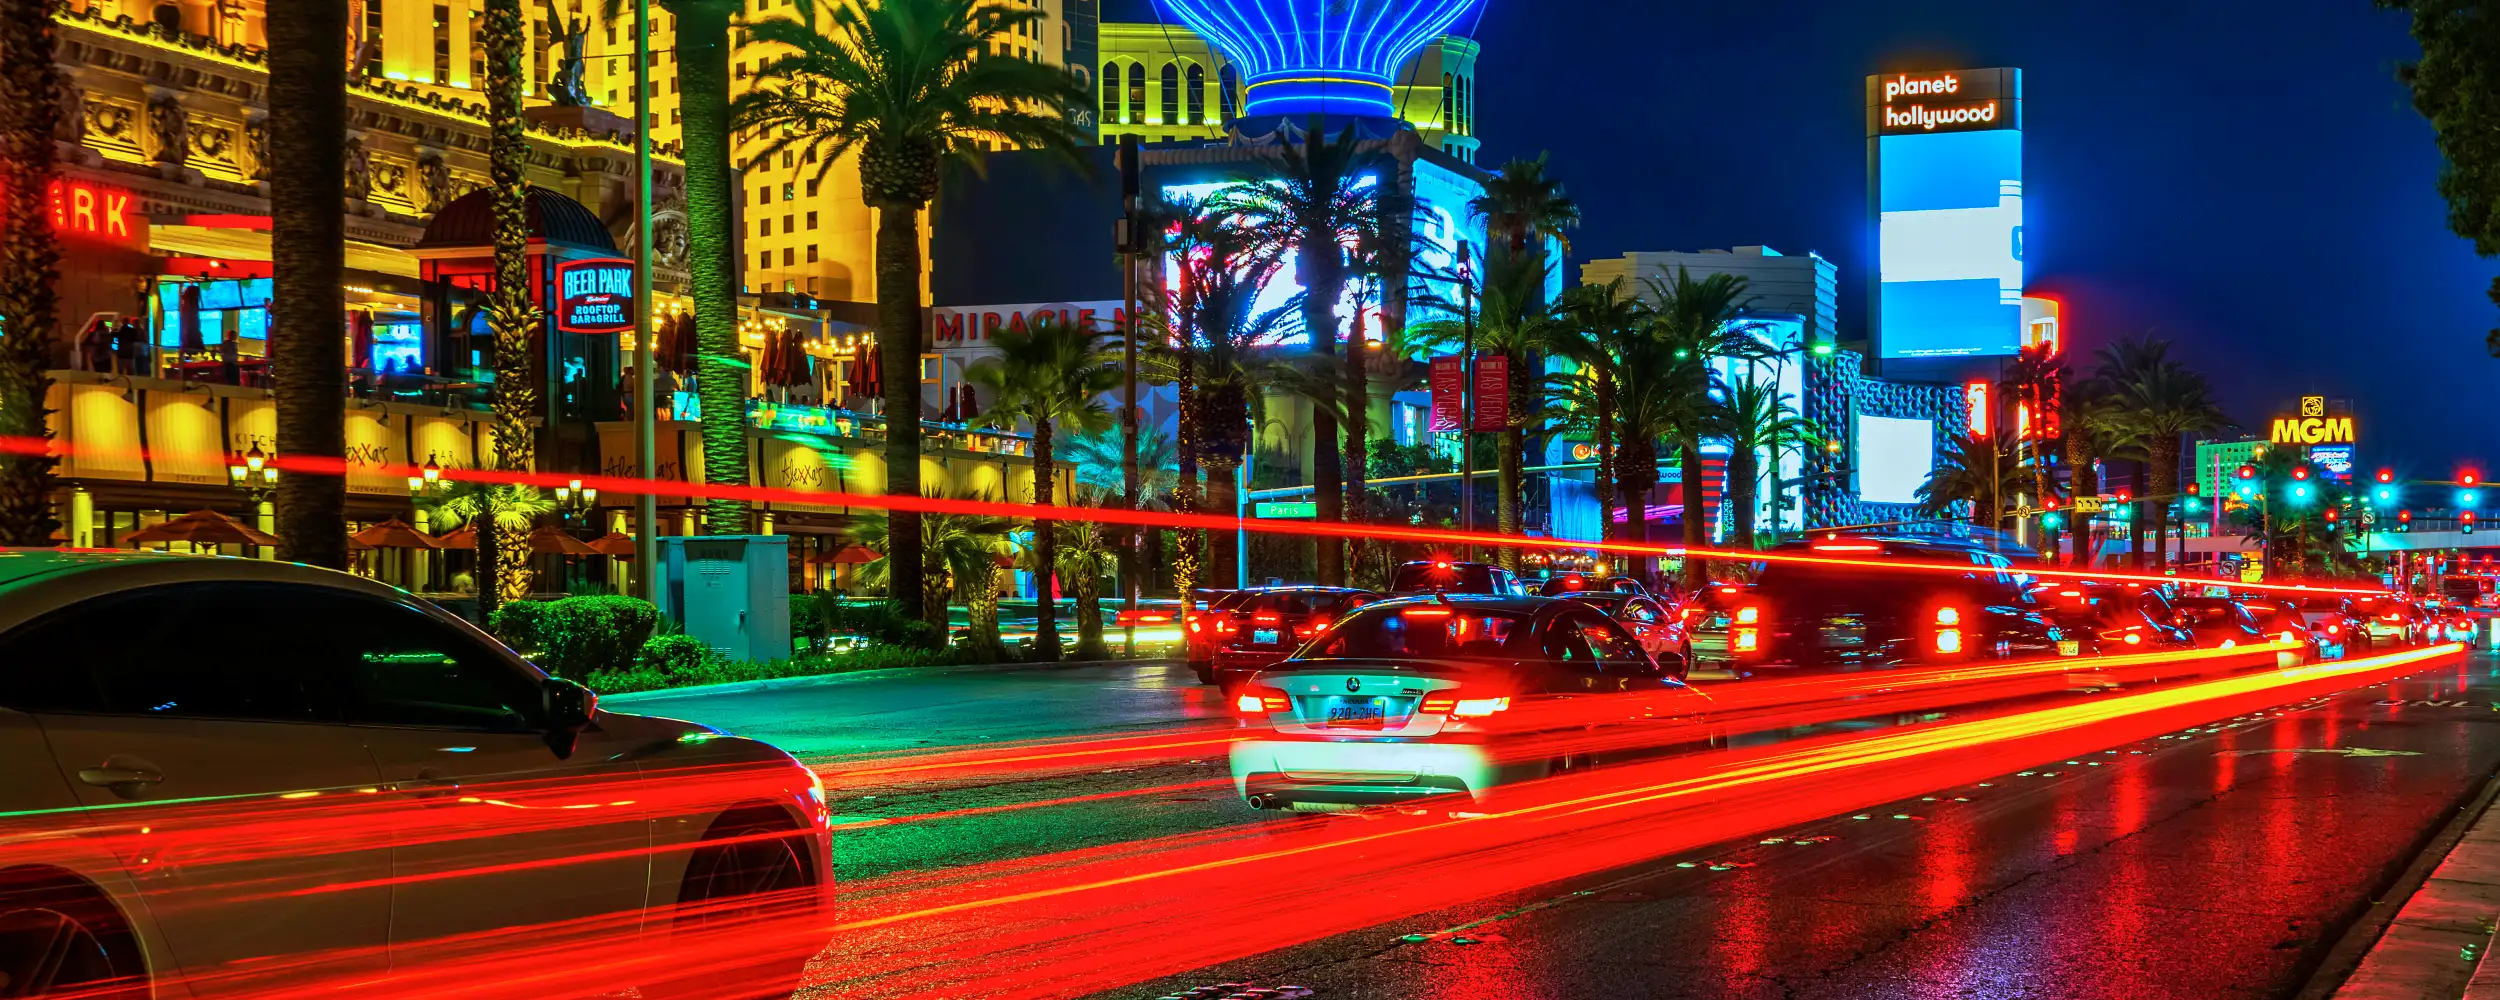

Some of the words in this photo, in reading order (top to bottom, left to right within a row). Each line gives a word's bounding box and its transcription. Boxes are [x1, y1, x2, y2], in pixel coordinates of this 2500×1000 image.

[1886, 75, 1958, 102] planet
[1886, 103, 1995, 130] hollywood
[564, 268, 597, 300] BEER
[598, 268, 632, 298] PARK
[570, 313, 626, 324] BAR&GRILL
[575, 304, 621, 315] ROOFTOP
[1435, 372, 1457, 390] LAS
[1480, 371, 1503, 389] LAS
[1480, 393, 1503, 427] VEGAS
[2271, 417, 2354, 444] MGM
[1270, 505, 1299, 515] Paris
